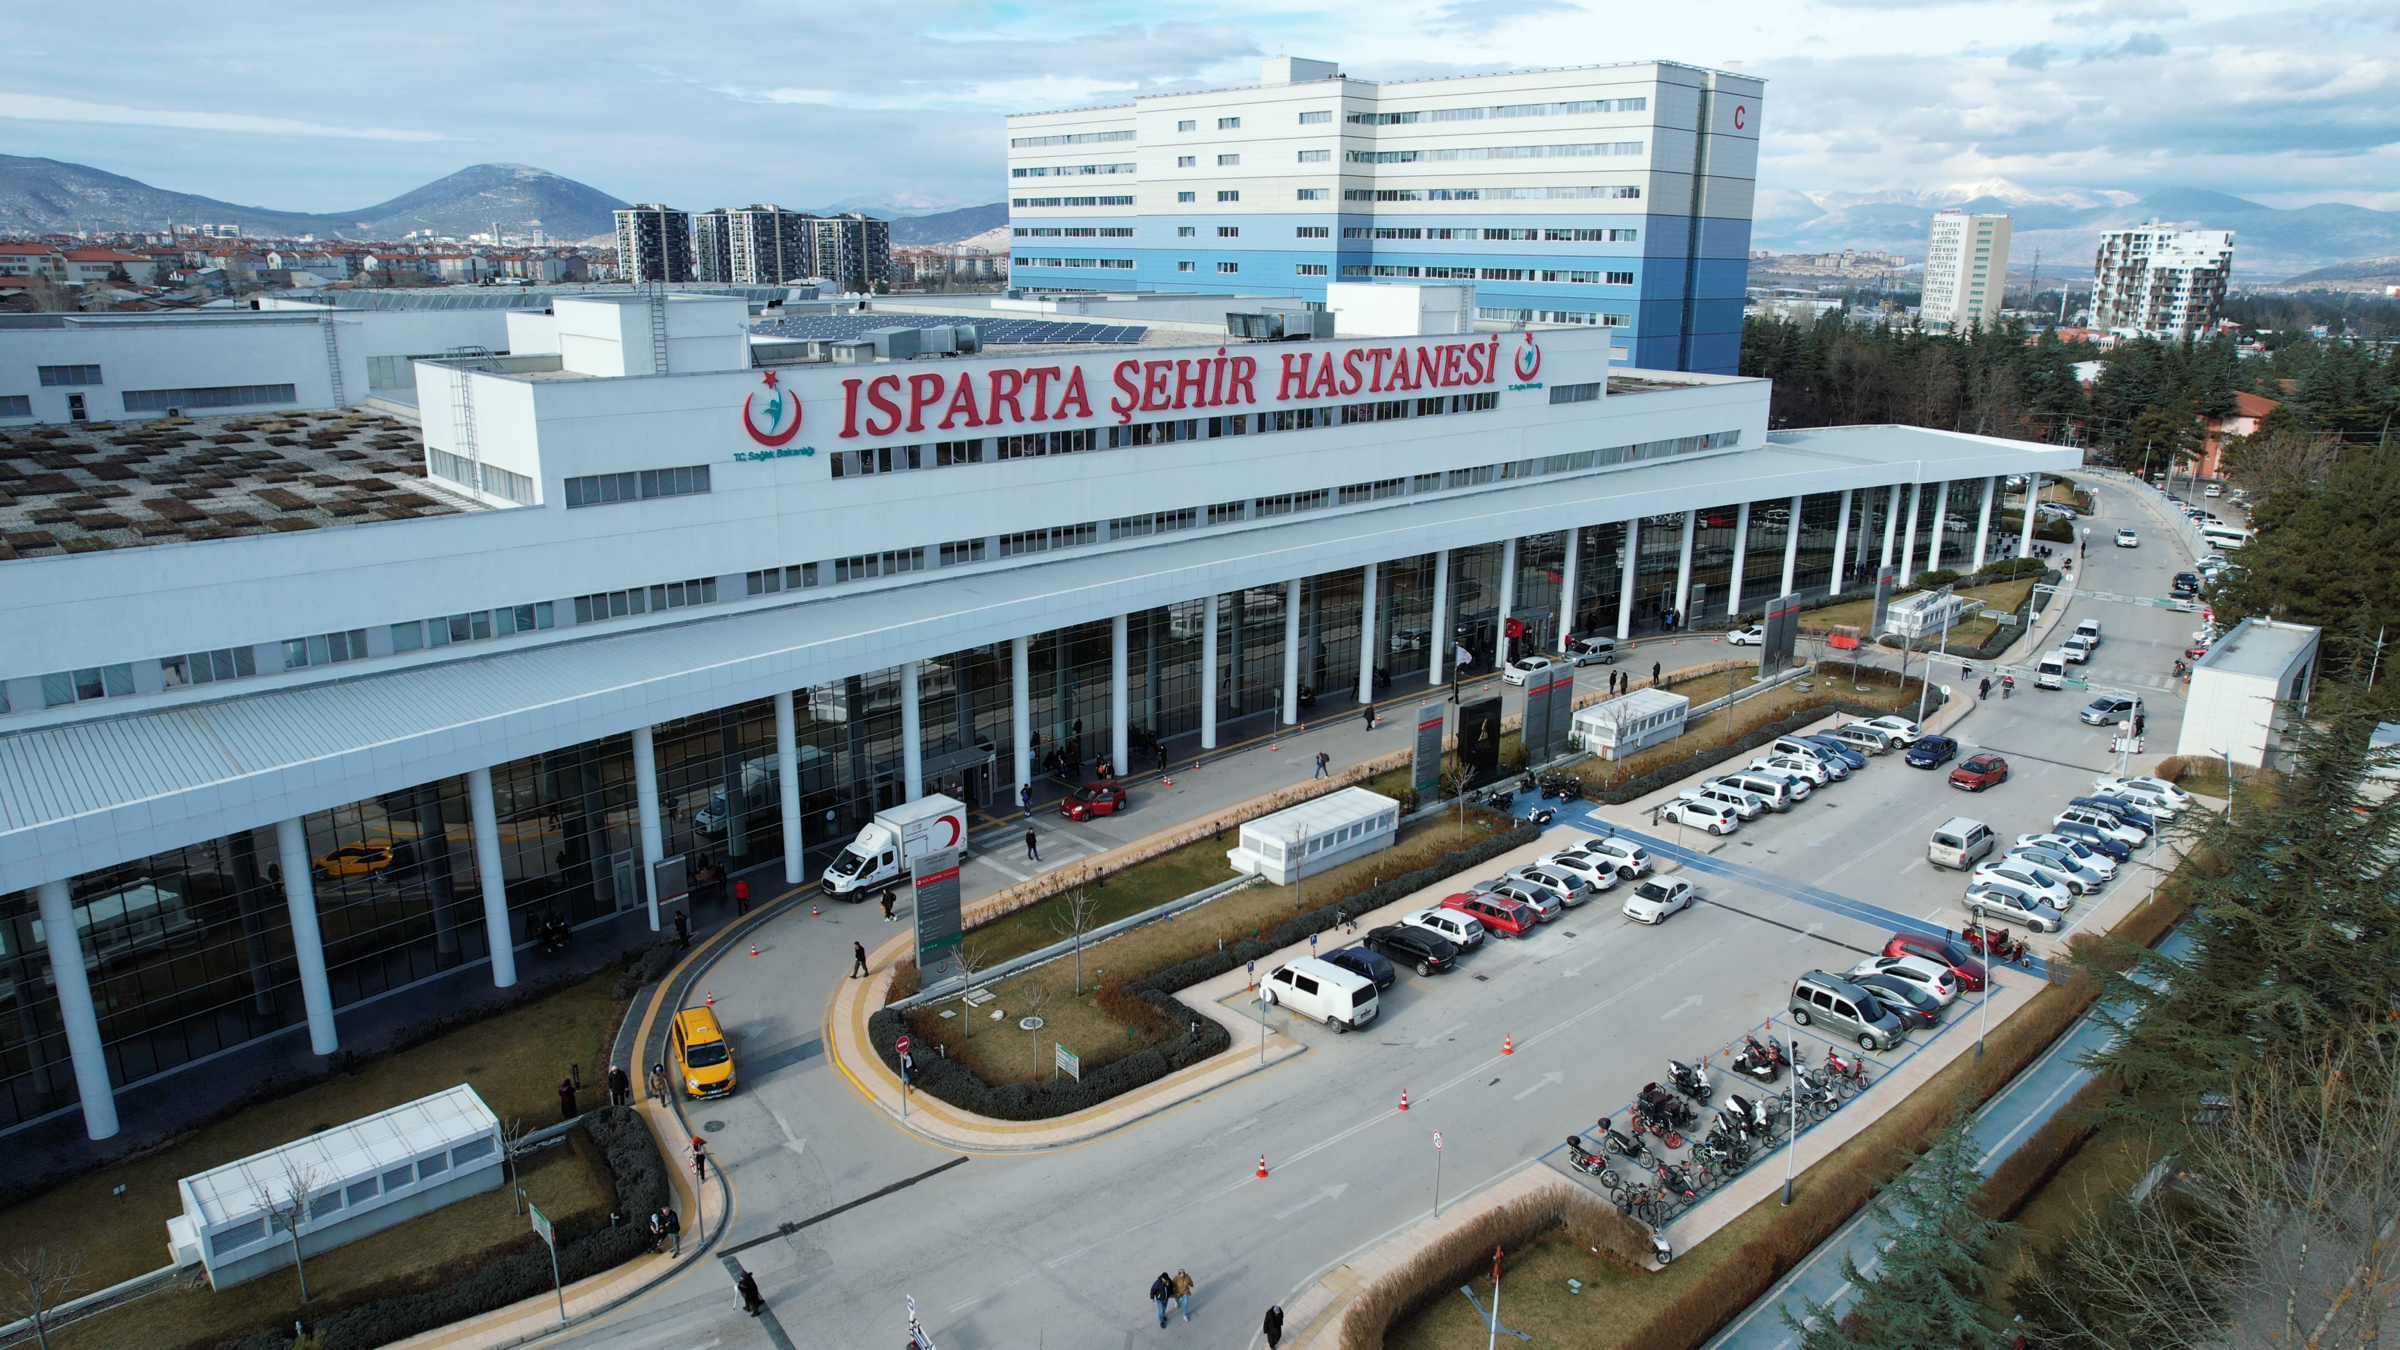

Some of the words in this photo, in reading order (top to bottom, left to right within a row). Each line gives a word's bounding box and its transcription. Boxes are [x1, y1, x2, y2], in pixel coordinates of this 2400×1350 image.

[1735, 105, 1745, 130] C
[838, 364, 1093, 438] ISPARTA
[1110, 346, 1257, 425] ŞEHİR
[1275, 333, 1500, 400] HASTANESİ
